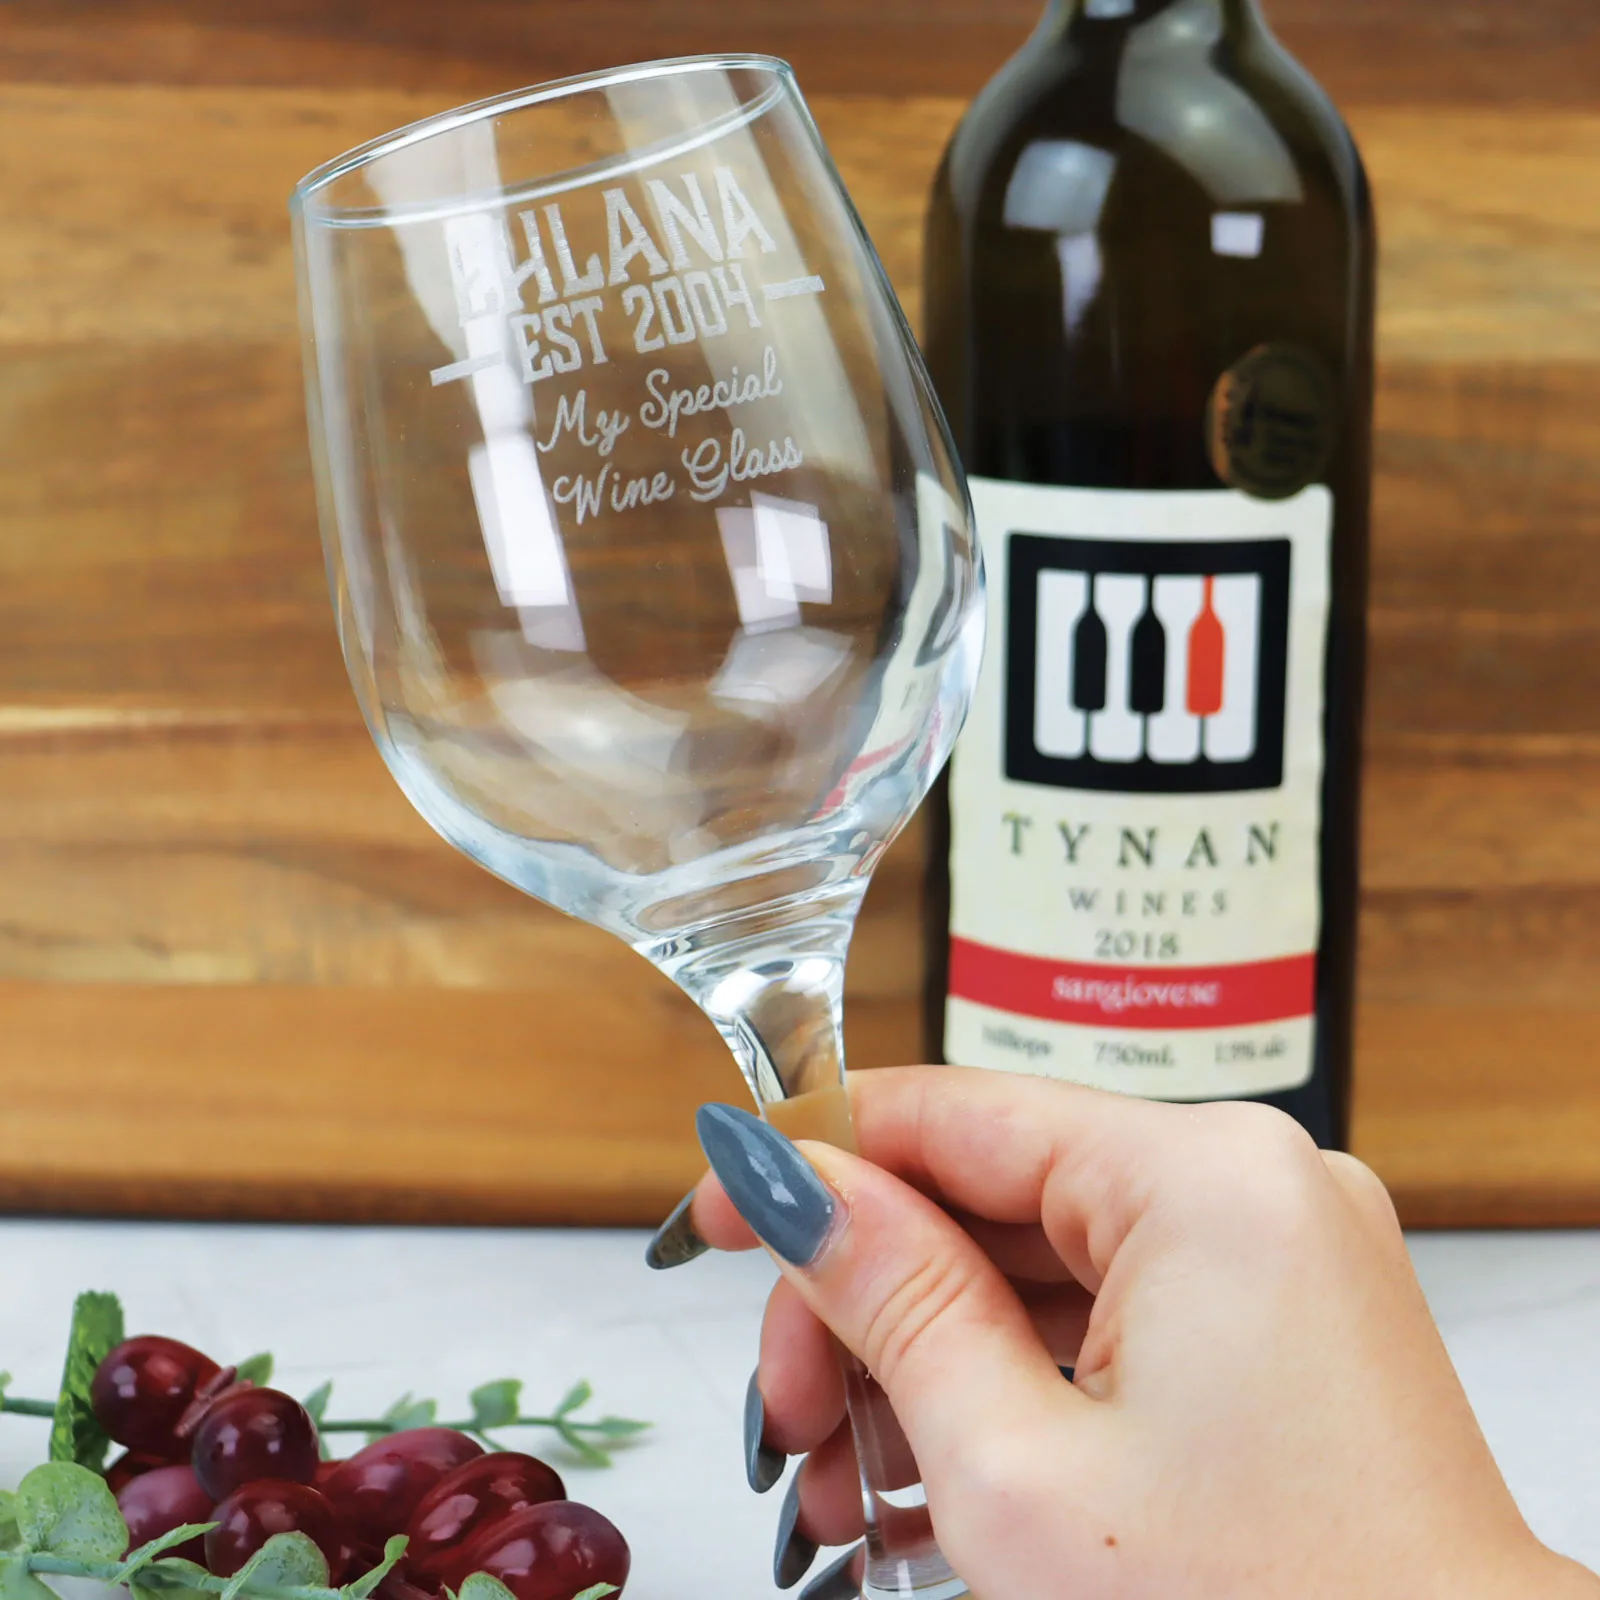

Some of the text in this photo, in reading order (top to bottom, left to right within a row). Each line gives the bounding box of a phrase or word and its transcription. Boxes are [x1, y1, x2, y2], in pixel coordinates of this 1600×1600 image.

[509, 262, 761, 384] EST 2004
[537, 345, 782, 456] My Special
[553, 427, 802, 525] Wine Glass
[1002, 811, 1281, 868] TYNAN
[1068, 888, 1229, 917] WINES
[1094, 929, 1179, 960] 2018
[1051, 974, 1222, 1013] sangiovese
